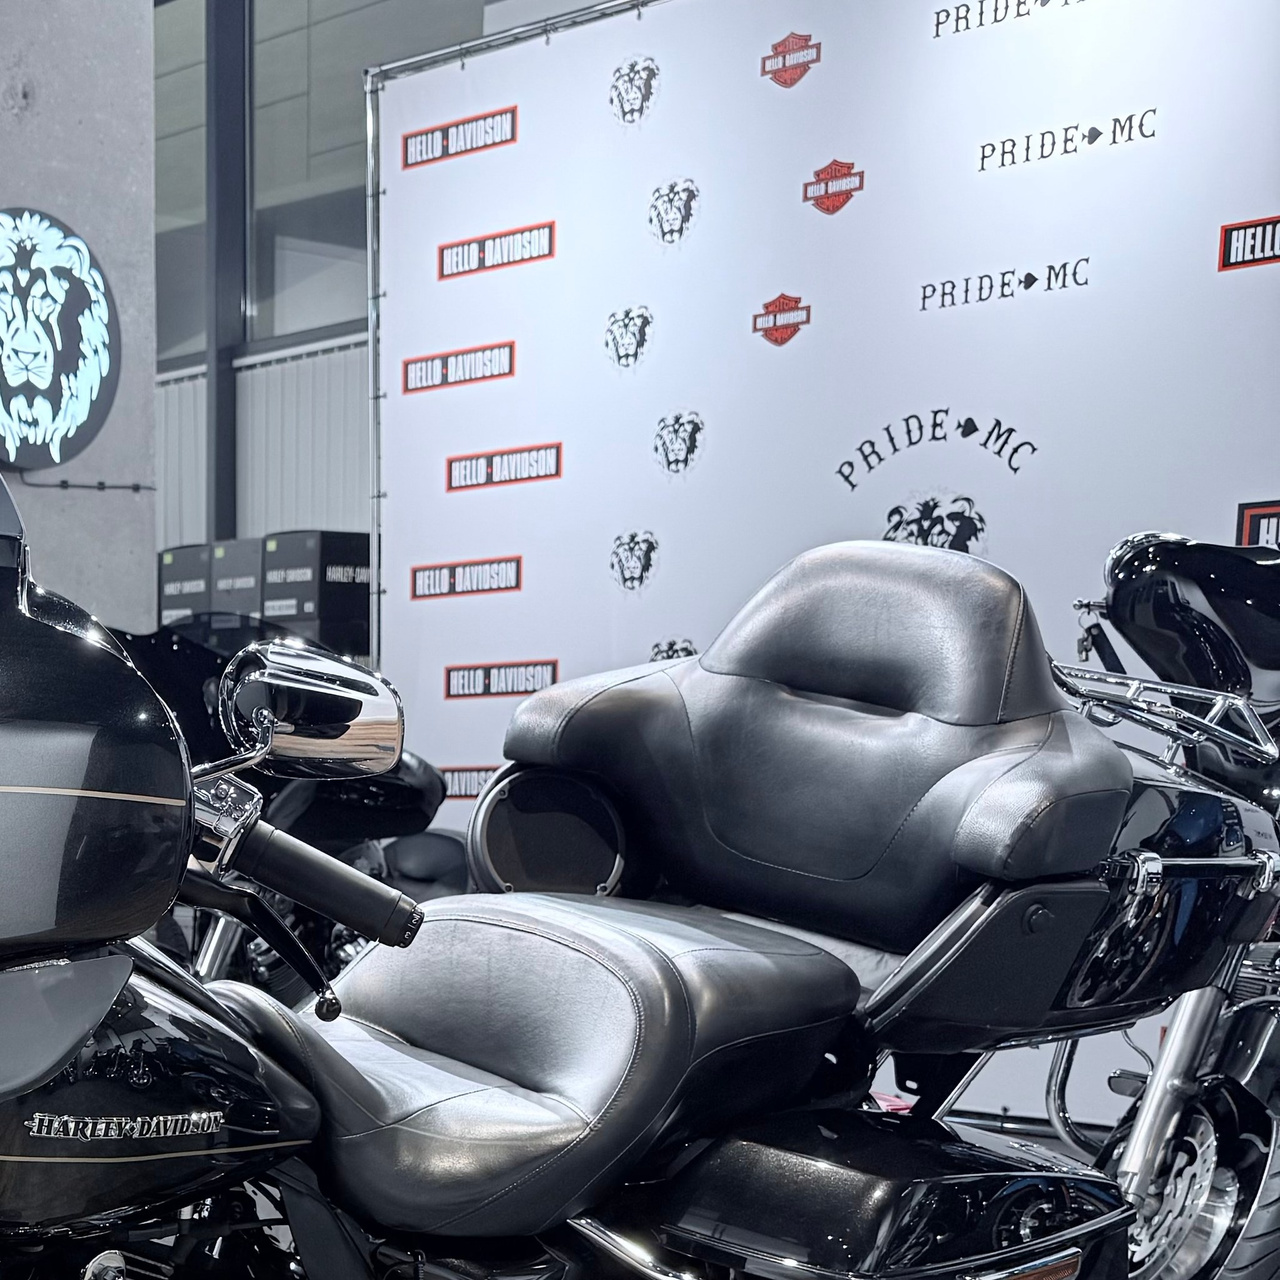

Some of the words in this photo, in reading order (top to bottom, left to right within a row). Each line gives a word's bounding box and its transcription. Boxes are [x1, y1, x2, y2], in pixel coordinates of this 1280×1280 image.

[407, 130, 443, 165] HELLO
[447, 112, 513, 155] DAVIDSON
[977, 124, 1080, 173] PRIDE
[1108, 107, 1158, 146] MC
[443, 242, 480, 276] HELLO
[484, 227, 551, 268] DAVIDSON
[919, 268, 1018, 312] PRIDE
[1043, 257, 1091, 292] MC
[407, 358, 443, 390] HELLO
[447, 346, 511, 383] DAVIDSON
[451, 457, 487, 488] HELLO
[492, 446, 557, 483] DAVIDSON
[834, 407, 951, 492] PRIDE
[978, 418, 1039, 475] MC
[415, 571, 451, 598] HELLO
[455, 559, 518, 593] DAVIDSON
[450, 668, 485, 696] HELLO
[490, 663, 553, 693] DAVIDSON
